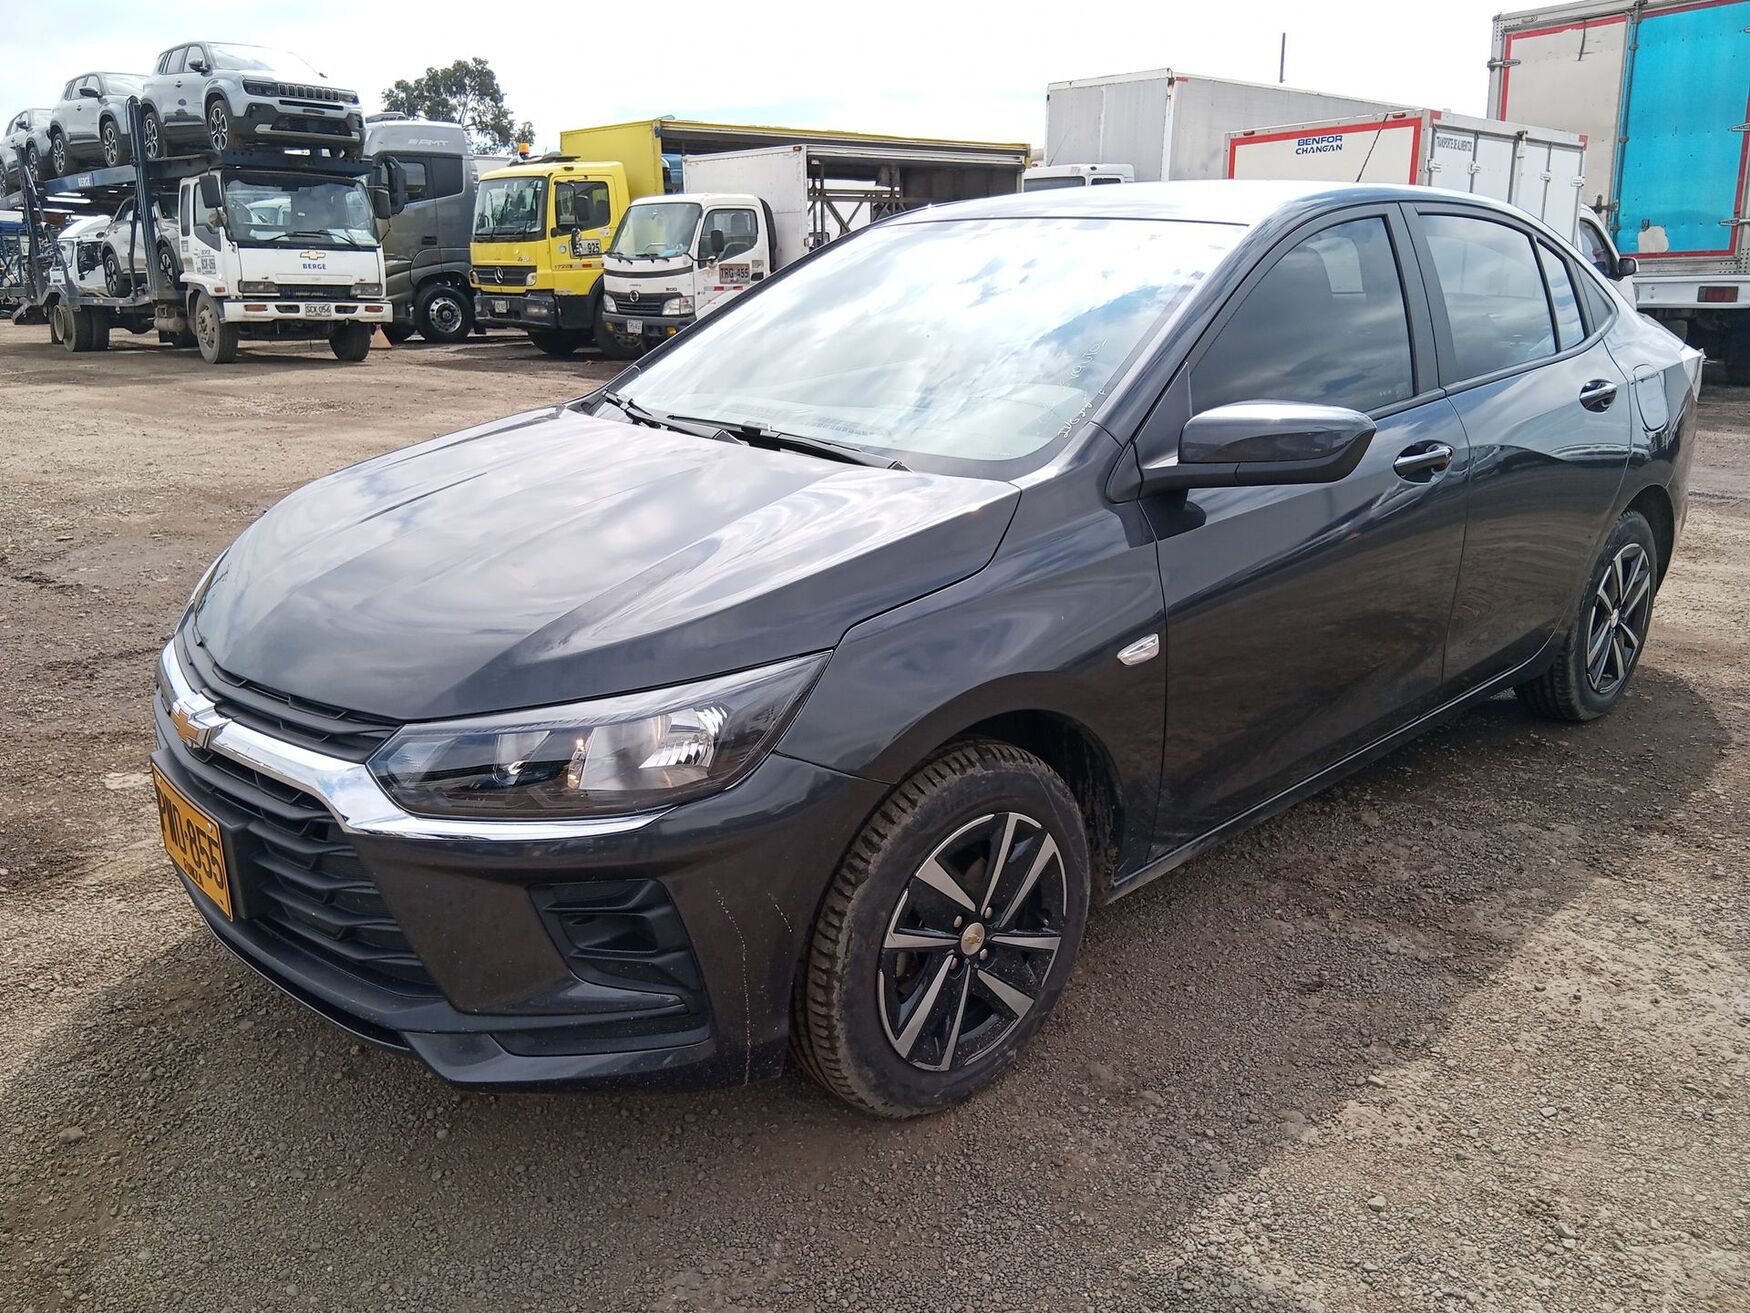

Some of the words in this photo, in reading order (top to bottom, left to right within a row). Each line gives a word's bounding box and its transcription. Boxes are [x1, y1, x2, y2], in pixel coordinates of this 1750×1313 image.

[1297, 135, 1343, 146] BENFOR
[1295, 144, 1343, 155] CHANGAN
[587, 242, 600, 253] 925
[720, 267, 734, 279] TRG
[735, 267, 749, 279] 455
